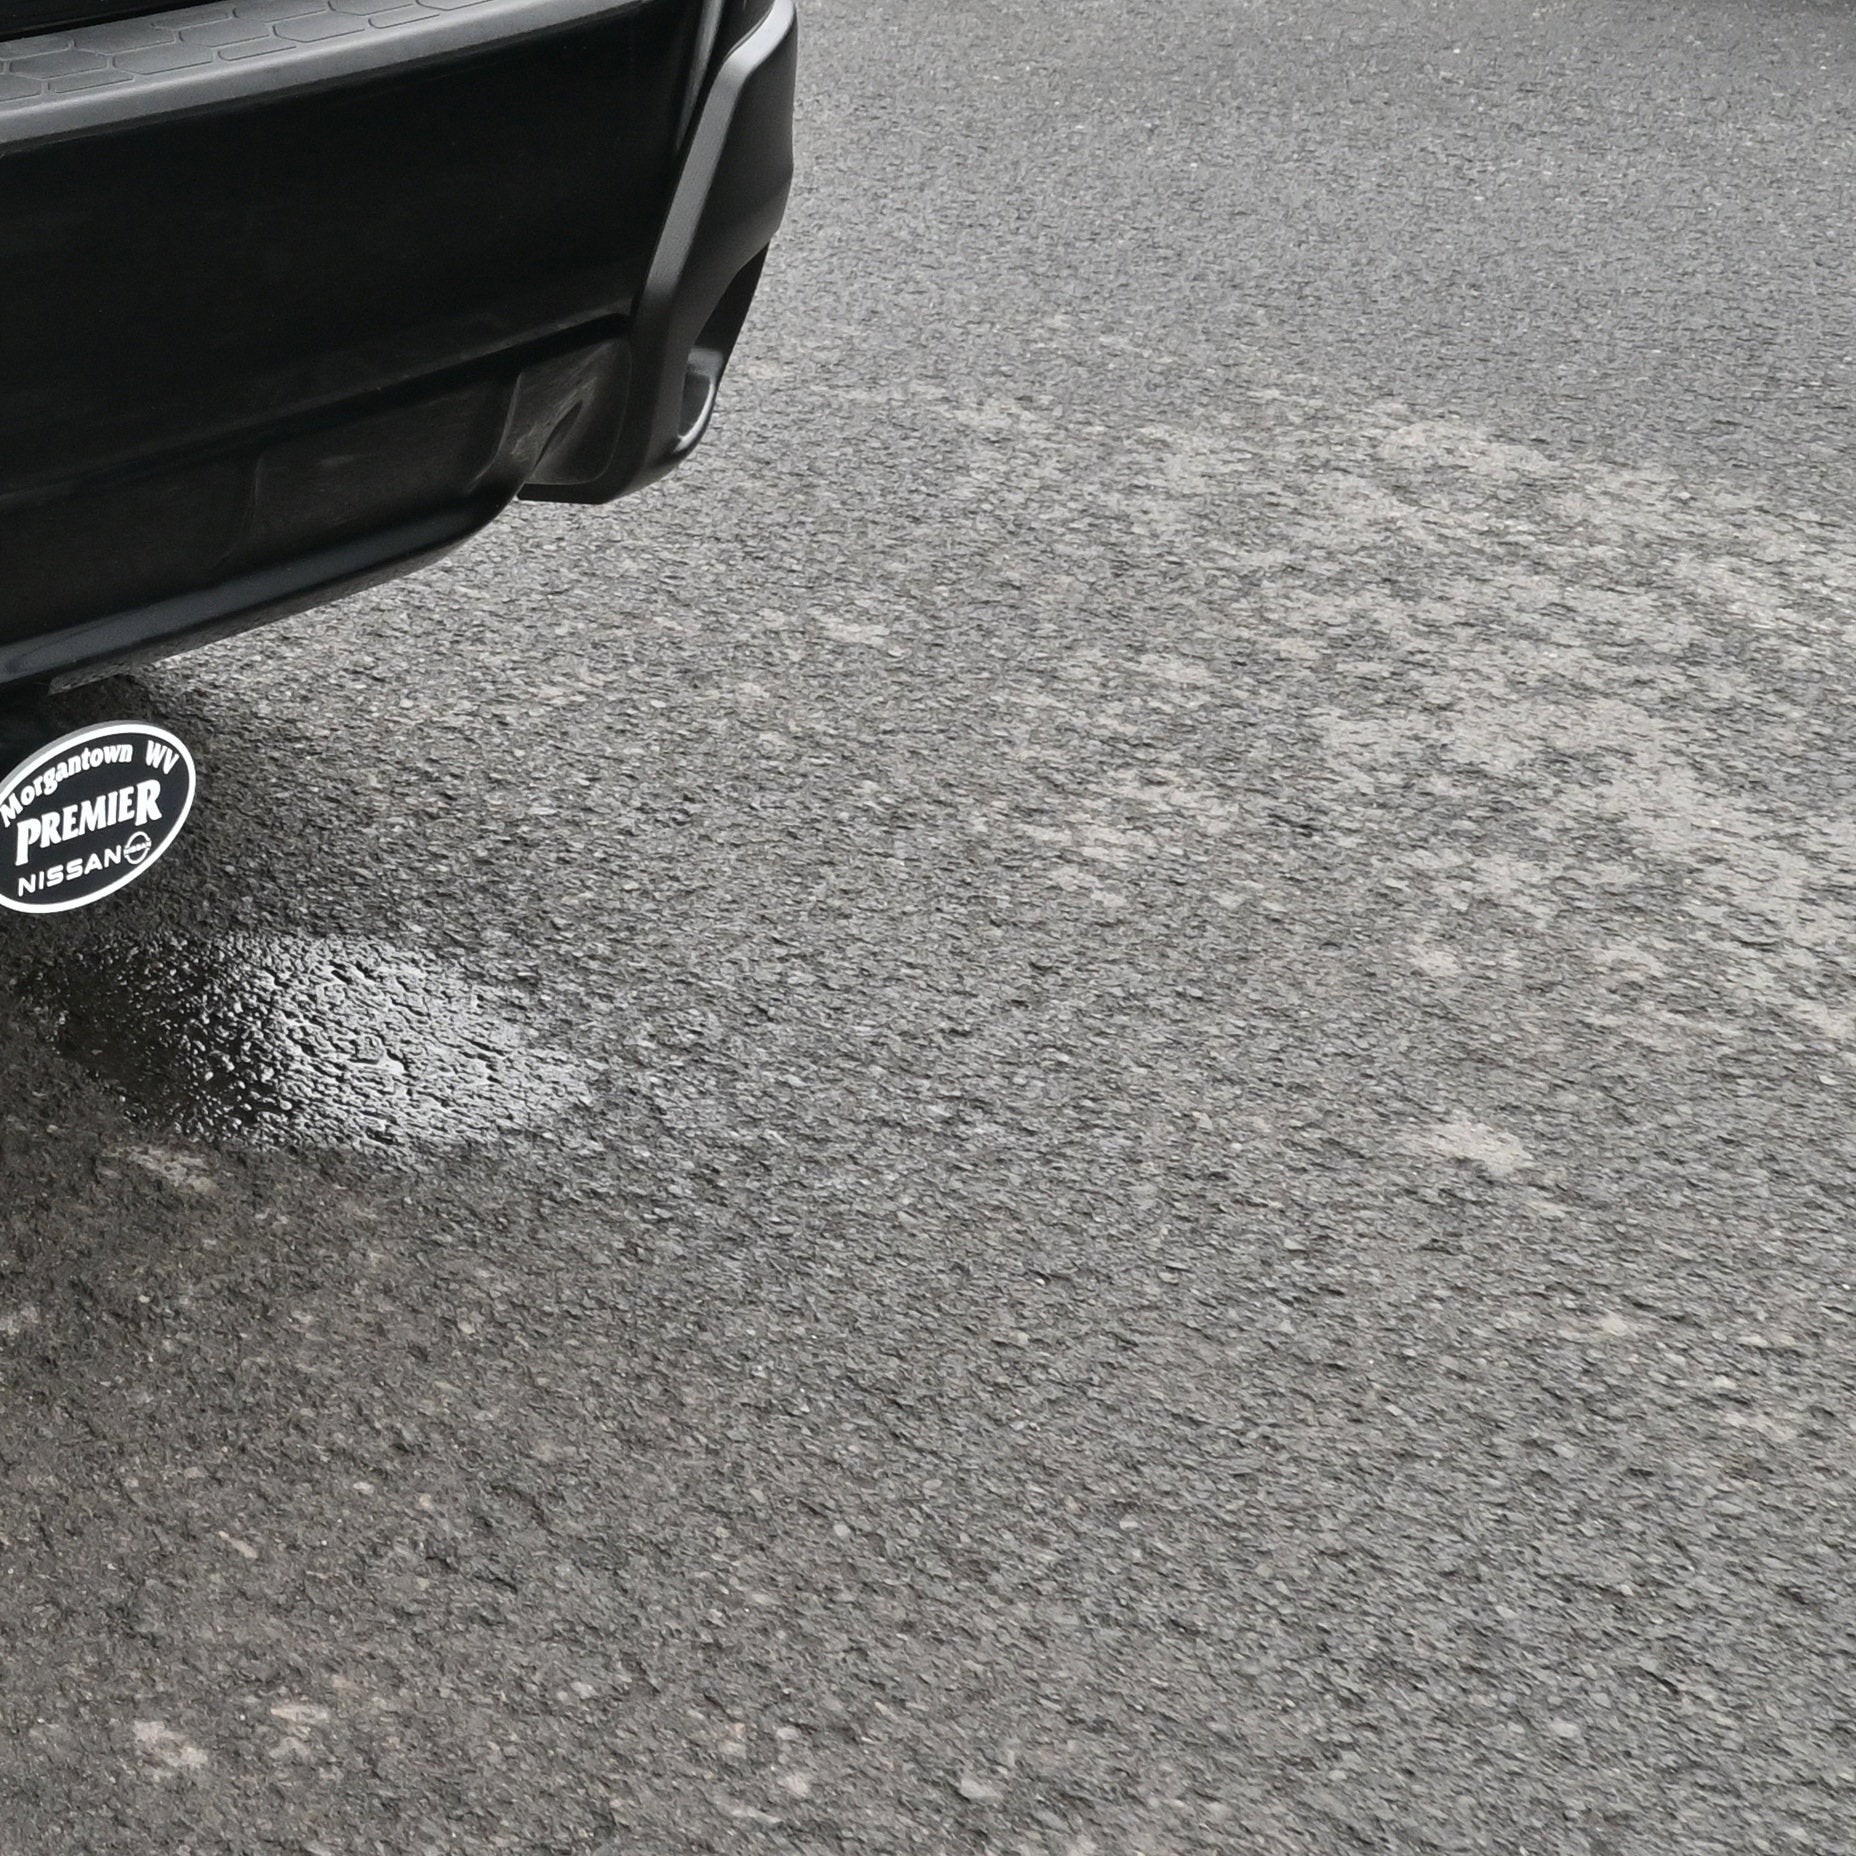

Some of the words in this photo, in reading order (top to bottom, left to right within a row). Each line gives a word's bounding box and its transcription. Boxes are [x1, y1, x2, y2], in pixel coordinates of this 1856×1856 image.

[145, 739, 180, 775] WV
[14, 779, 163, 867] PREMIER
[18, 845, 123, 897] NISSAN
